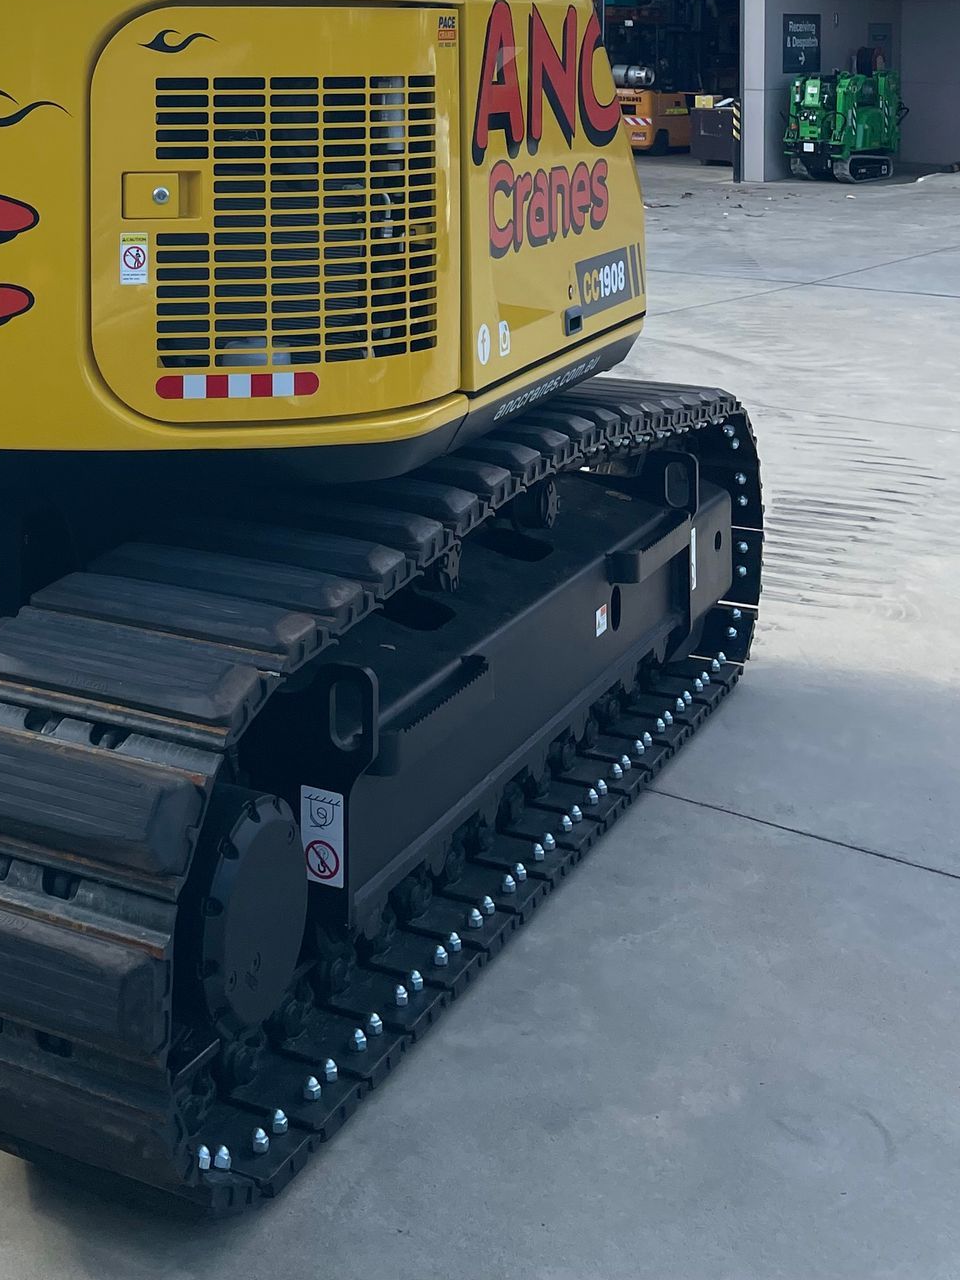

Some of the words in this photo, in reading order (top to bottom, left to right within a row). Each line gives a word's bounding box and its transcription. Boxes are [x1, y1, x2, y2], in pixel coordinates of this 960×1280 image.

[438, 16, 456, 28] PACE
[788, 21, 816, 34] Receiving
[792, 36, 818, 50] Despatch
[489, 157, 609, 258] Cranes
[583, 260, 625, 305] CC1908
[493, 355, 602, 421] anccranes.com.au
